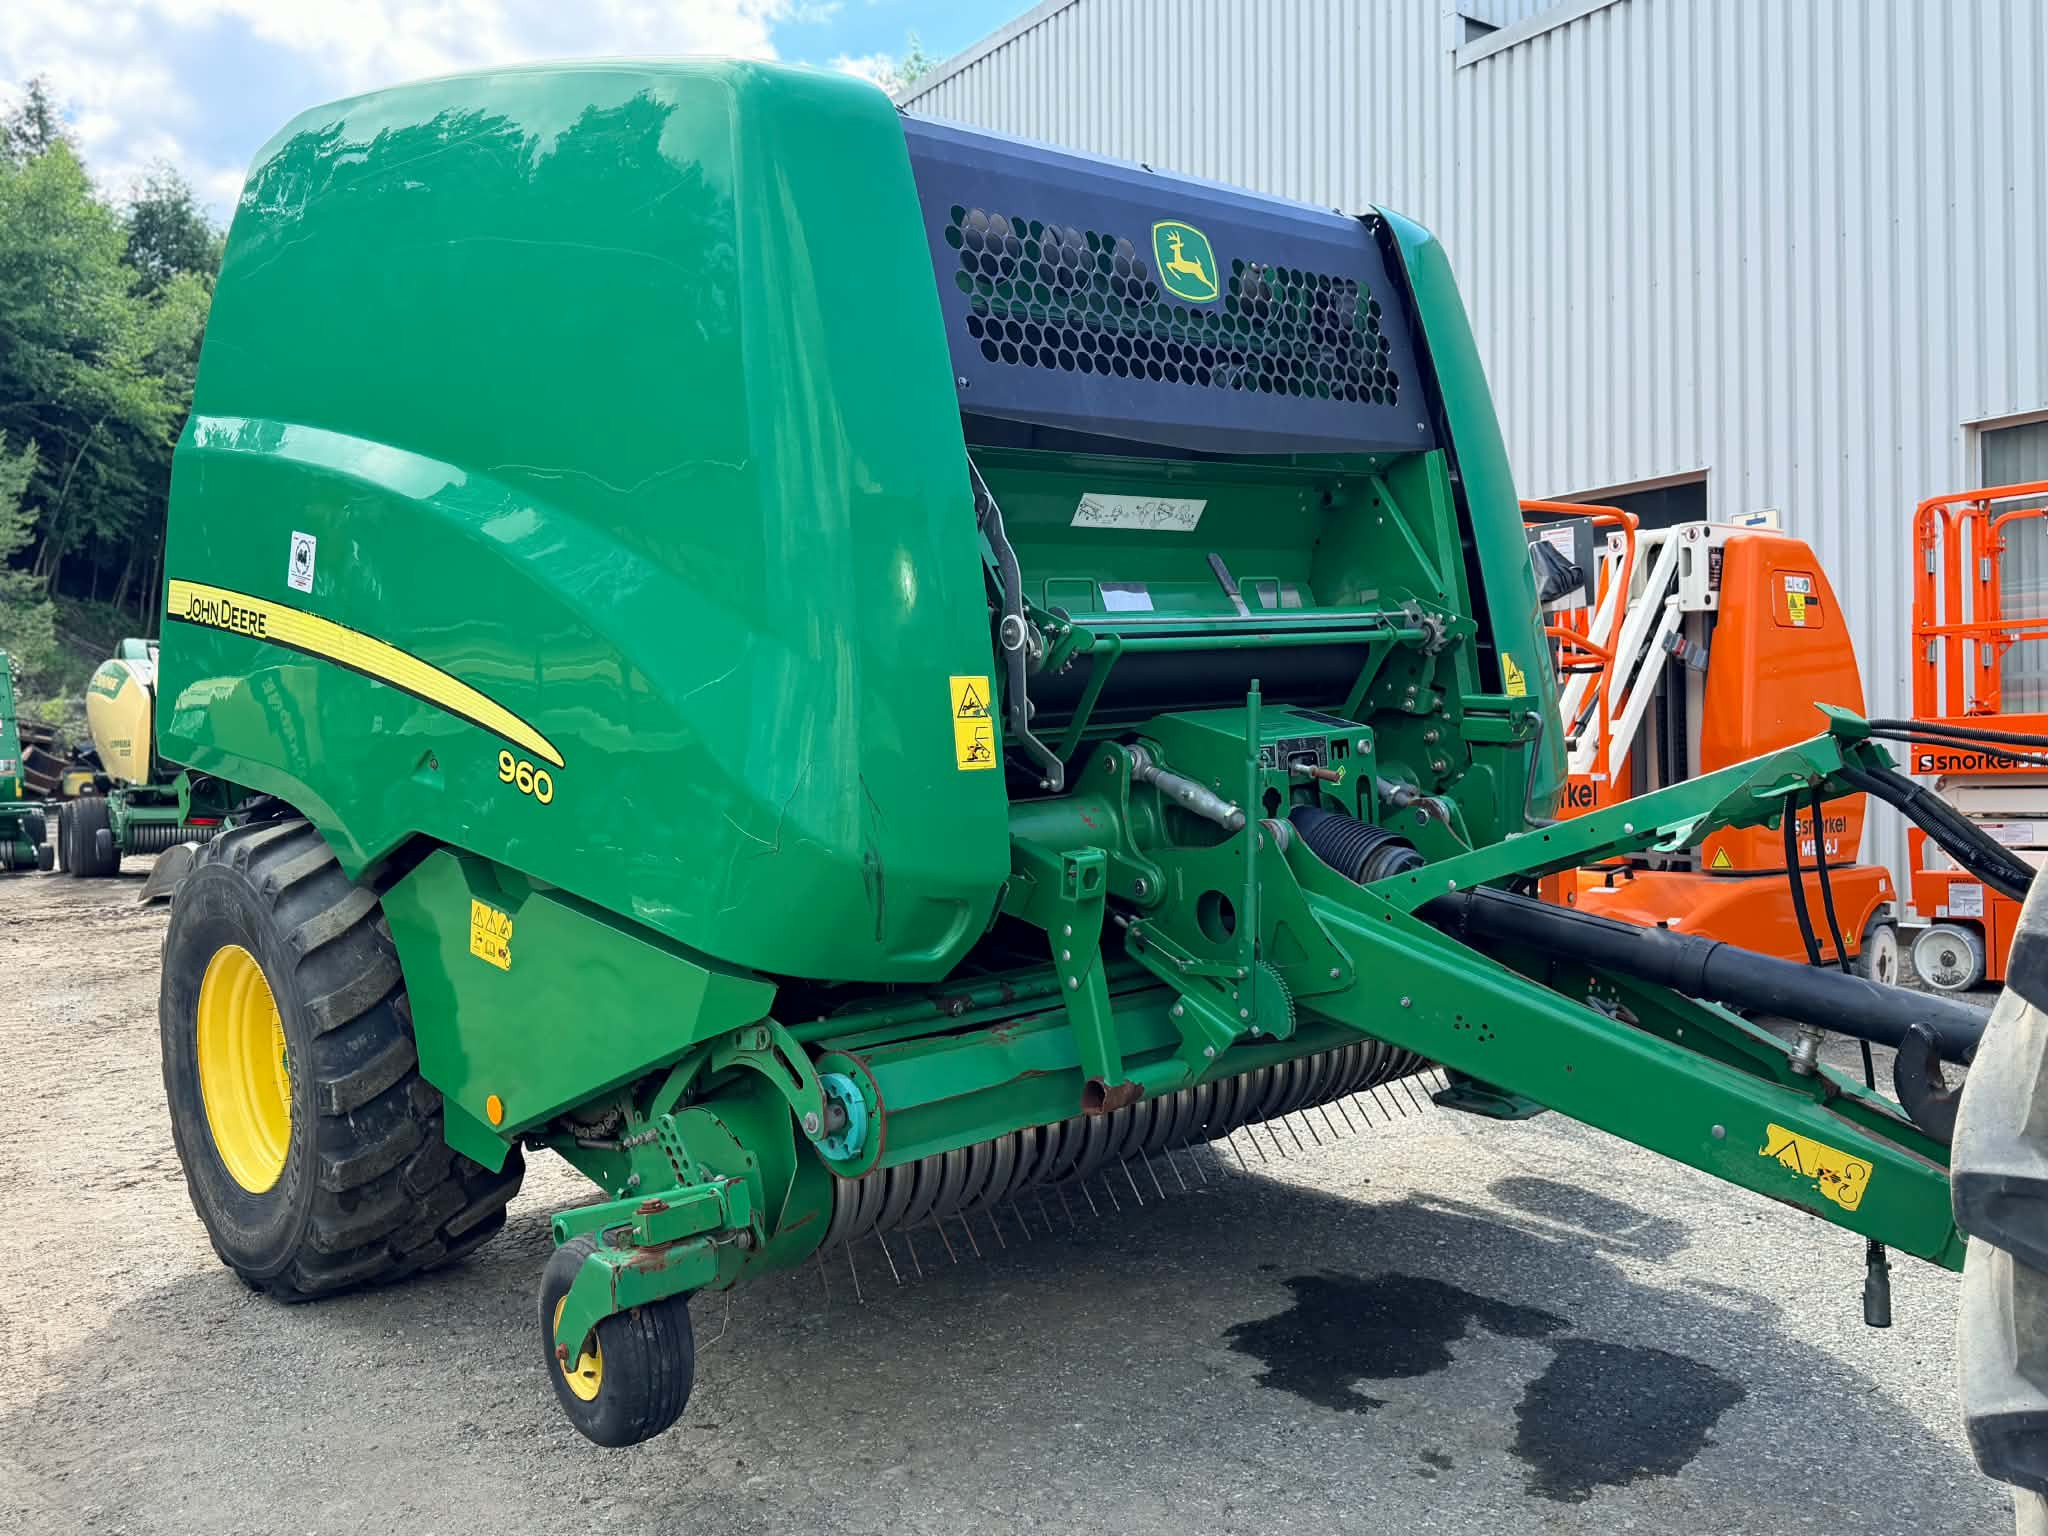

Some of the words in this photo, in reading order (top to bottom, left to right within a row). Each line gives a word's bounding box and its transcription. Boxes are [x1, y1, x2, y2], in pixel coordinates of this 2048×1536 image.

[186, 592, 219, 622] JOHN
[221, 600, 267, 635] DEERE
[498, 749, 554, 805] 960
